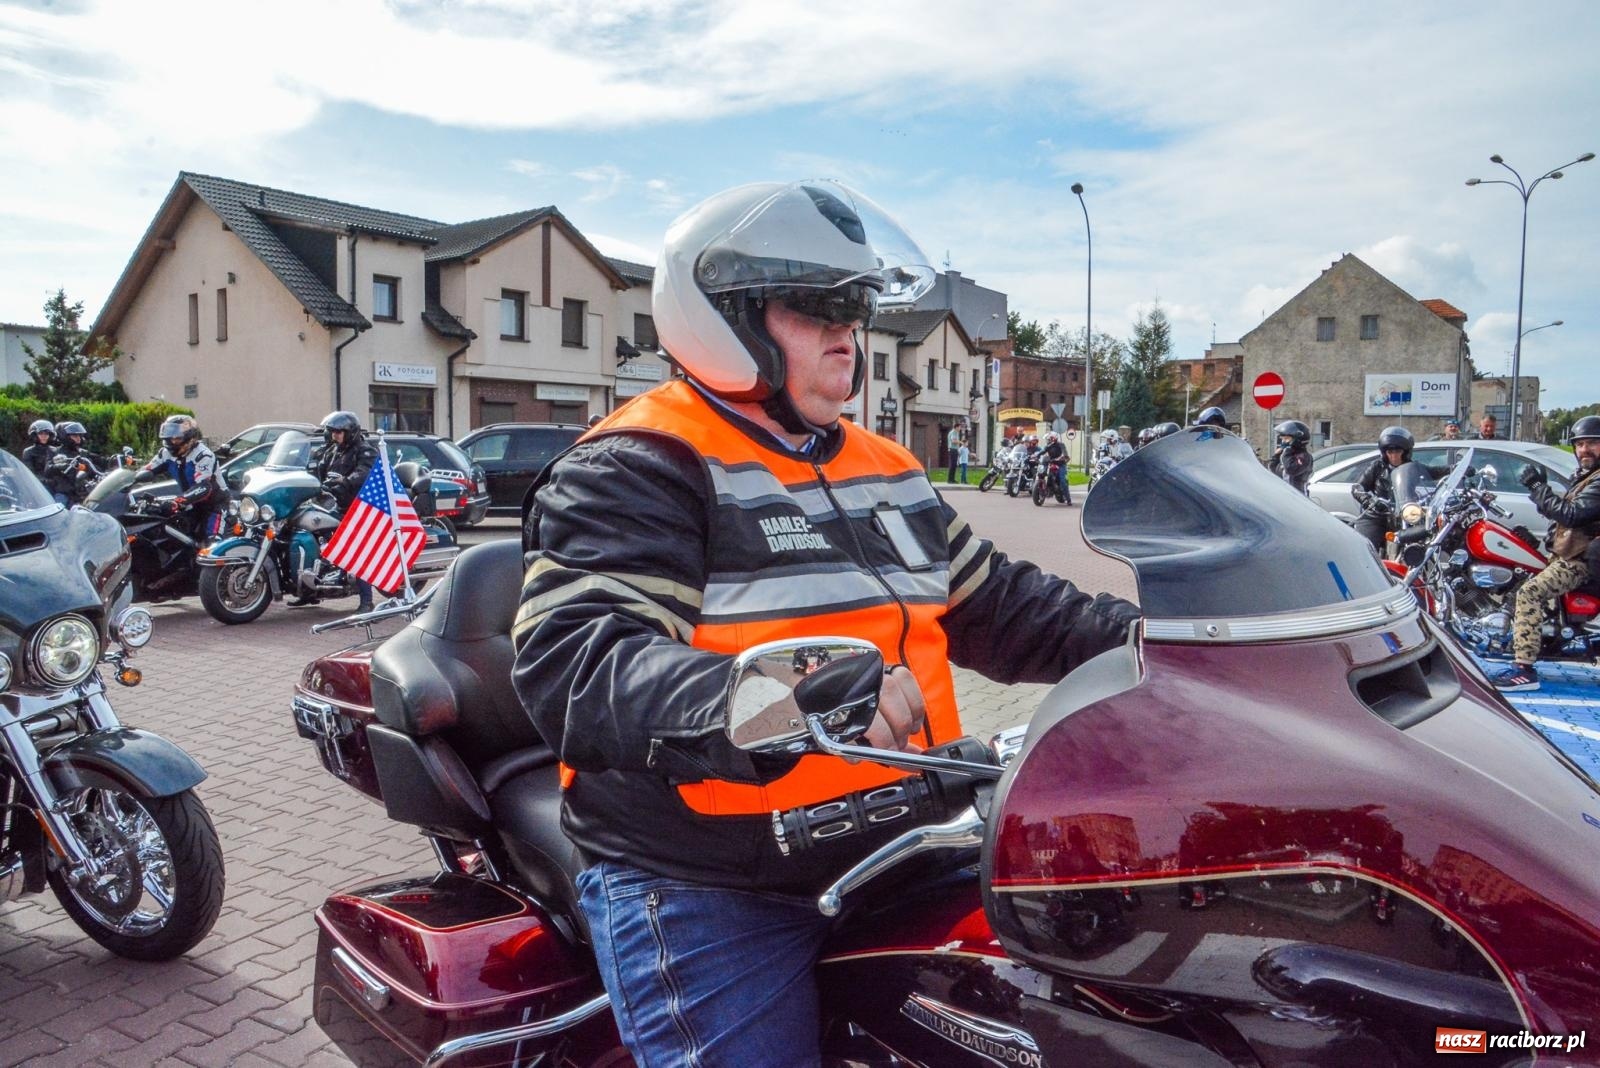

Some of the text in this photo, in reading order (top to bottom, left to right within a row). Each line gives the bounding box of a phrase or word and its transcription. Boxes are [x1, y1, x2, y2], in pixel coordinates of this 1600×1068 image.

[1421, 381, 1450, 391] Dom
[758, 516, 813, 536] HARLEY-
[910, 1000, 1043, 1068] HARLEY-DAVIDSON
